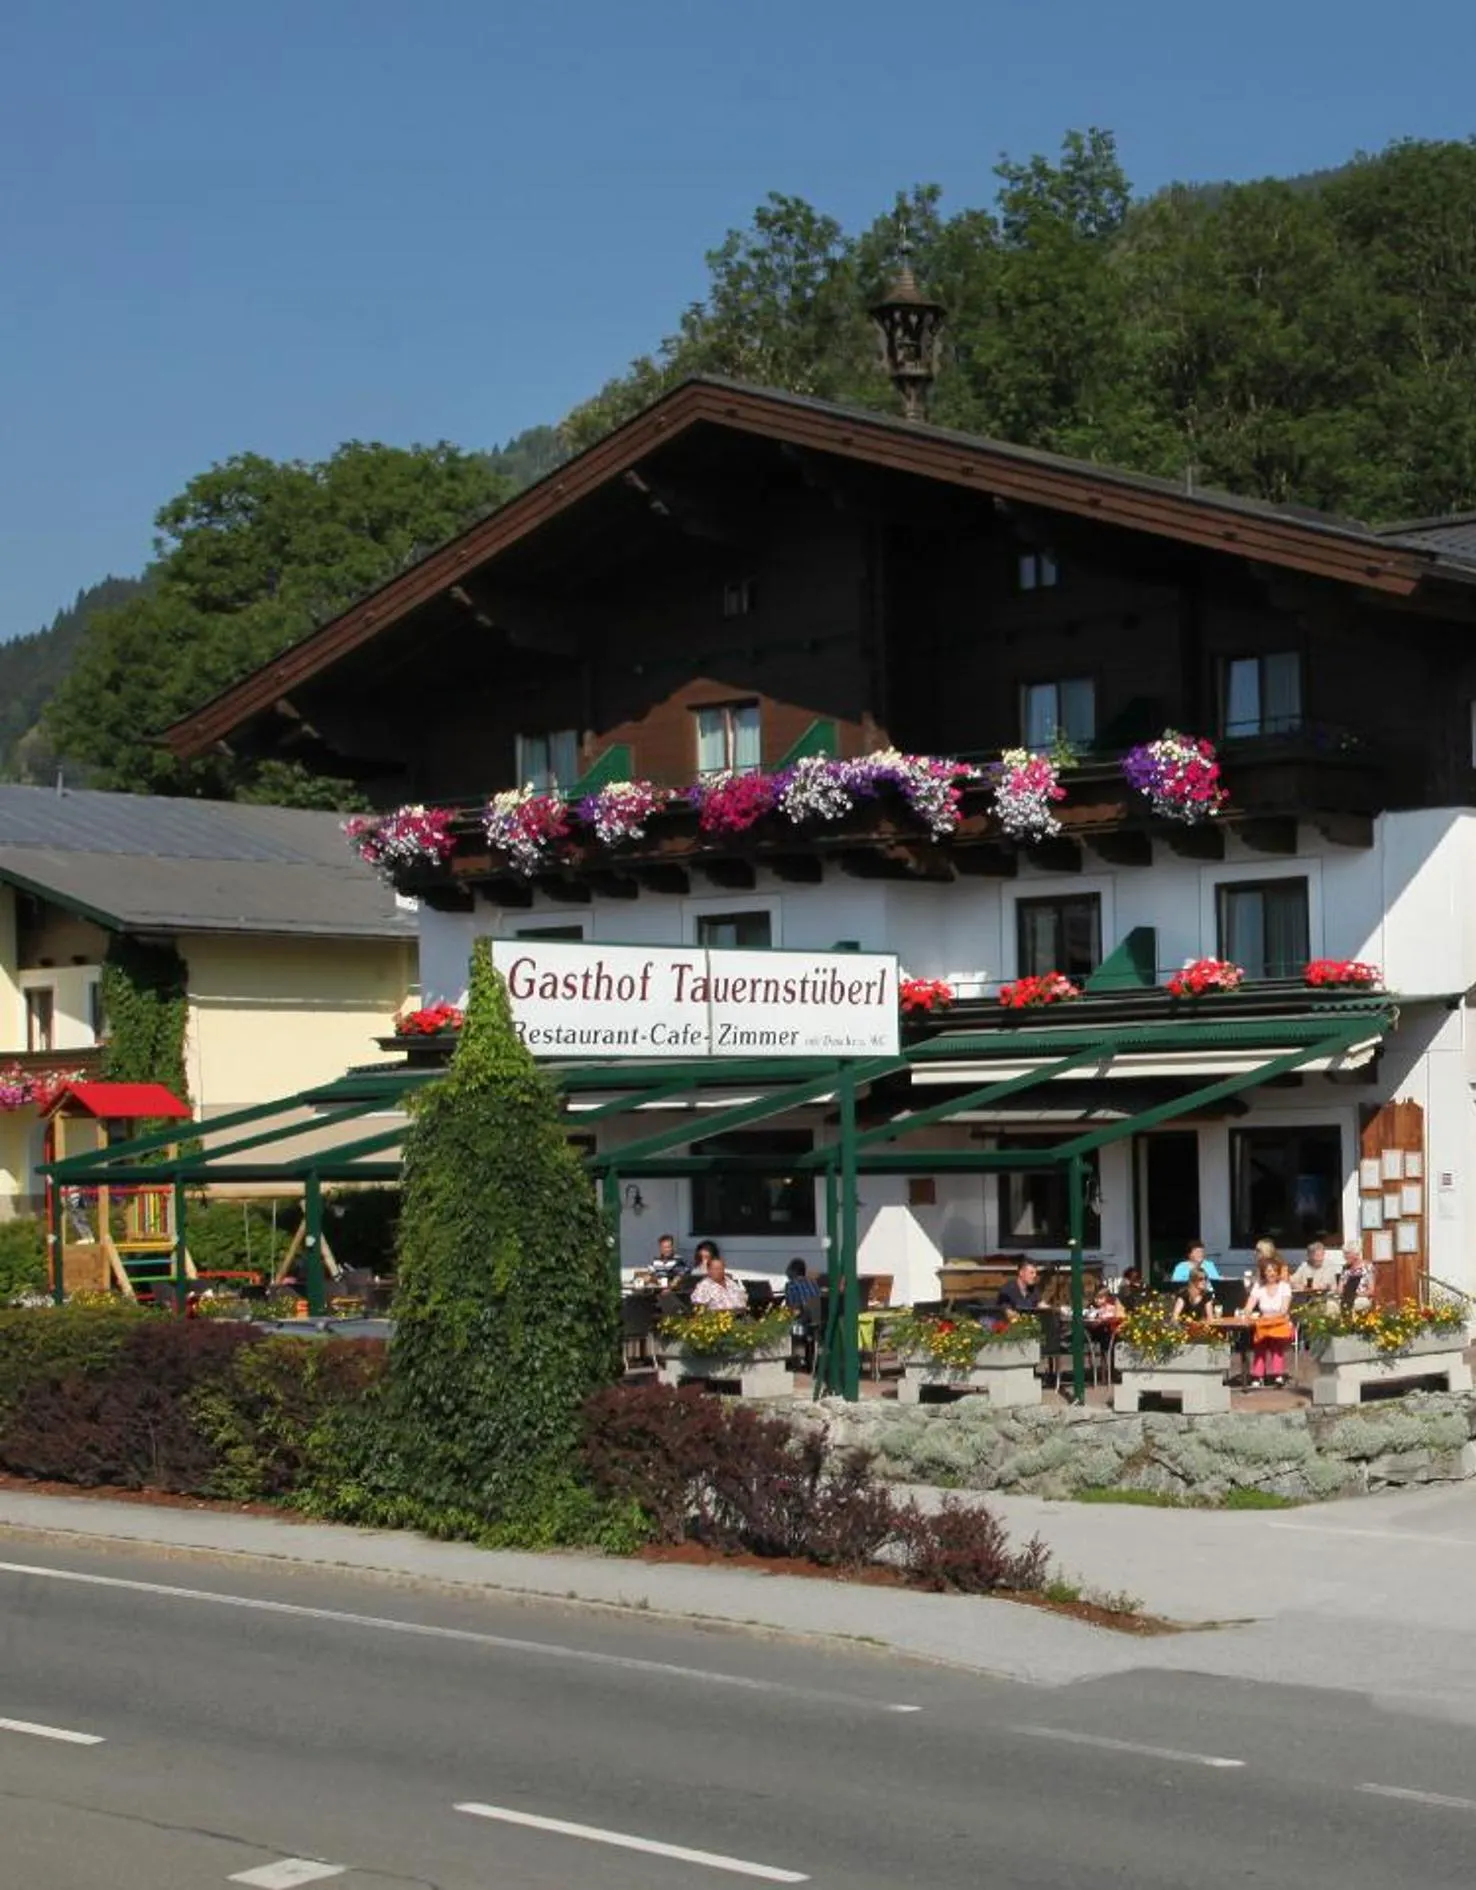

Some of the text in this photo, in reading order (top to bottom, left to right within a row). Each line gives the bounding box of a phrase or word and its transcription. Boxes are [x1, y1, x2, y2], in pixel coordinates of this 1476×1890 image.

[508, 957, 887, 1006] Gasthof Tauernstüberl
[717, 1023, 800, 1047] Zimmer
